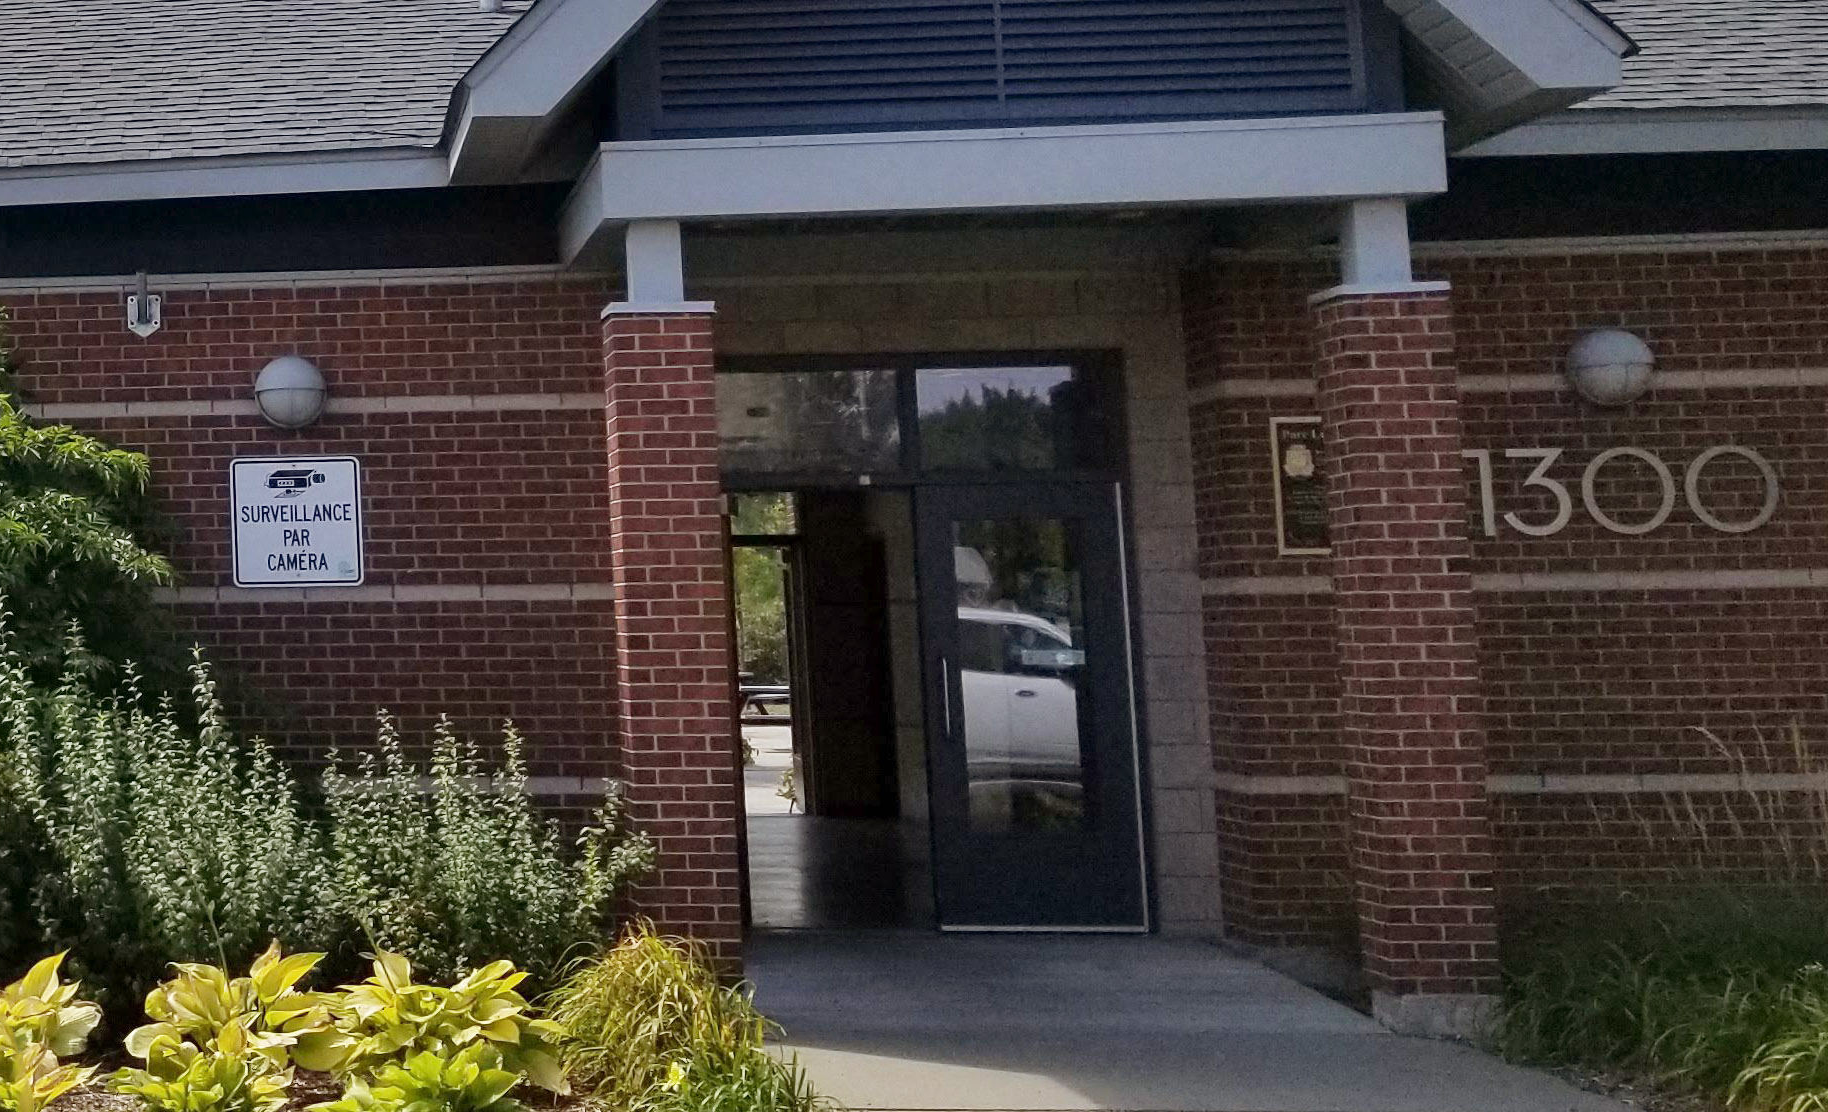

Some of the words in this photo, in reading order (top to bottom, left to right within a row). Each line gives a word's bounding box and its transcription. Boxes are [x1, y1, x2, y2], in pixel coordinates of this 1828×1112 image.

[1461, 444, 1779, 537] 1300
[241, 503, 352, 523] SURVEILLANCE
[283, 528, 311, 547] PAR
[267, 549, 329, 571] CAMÉRA
